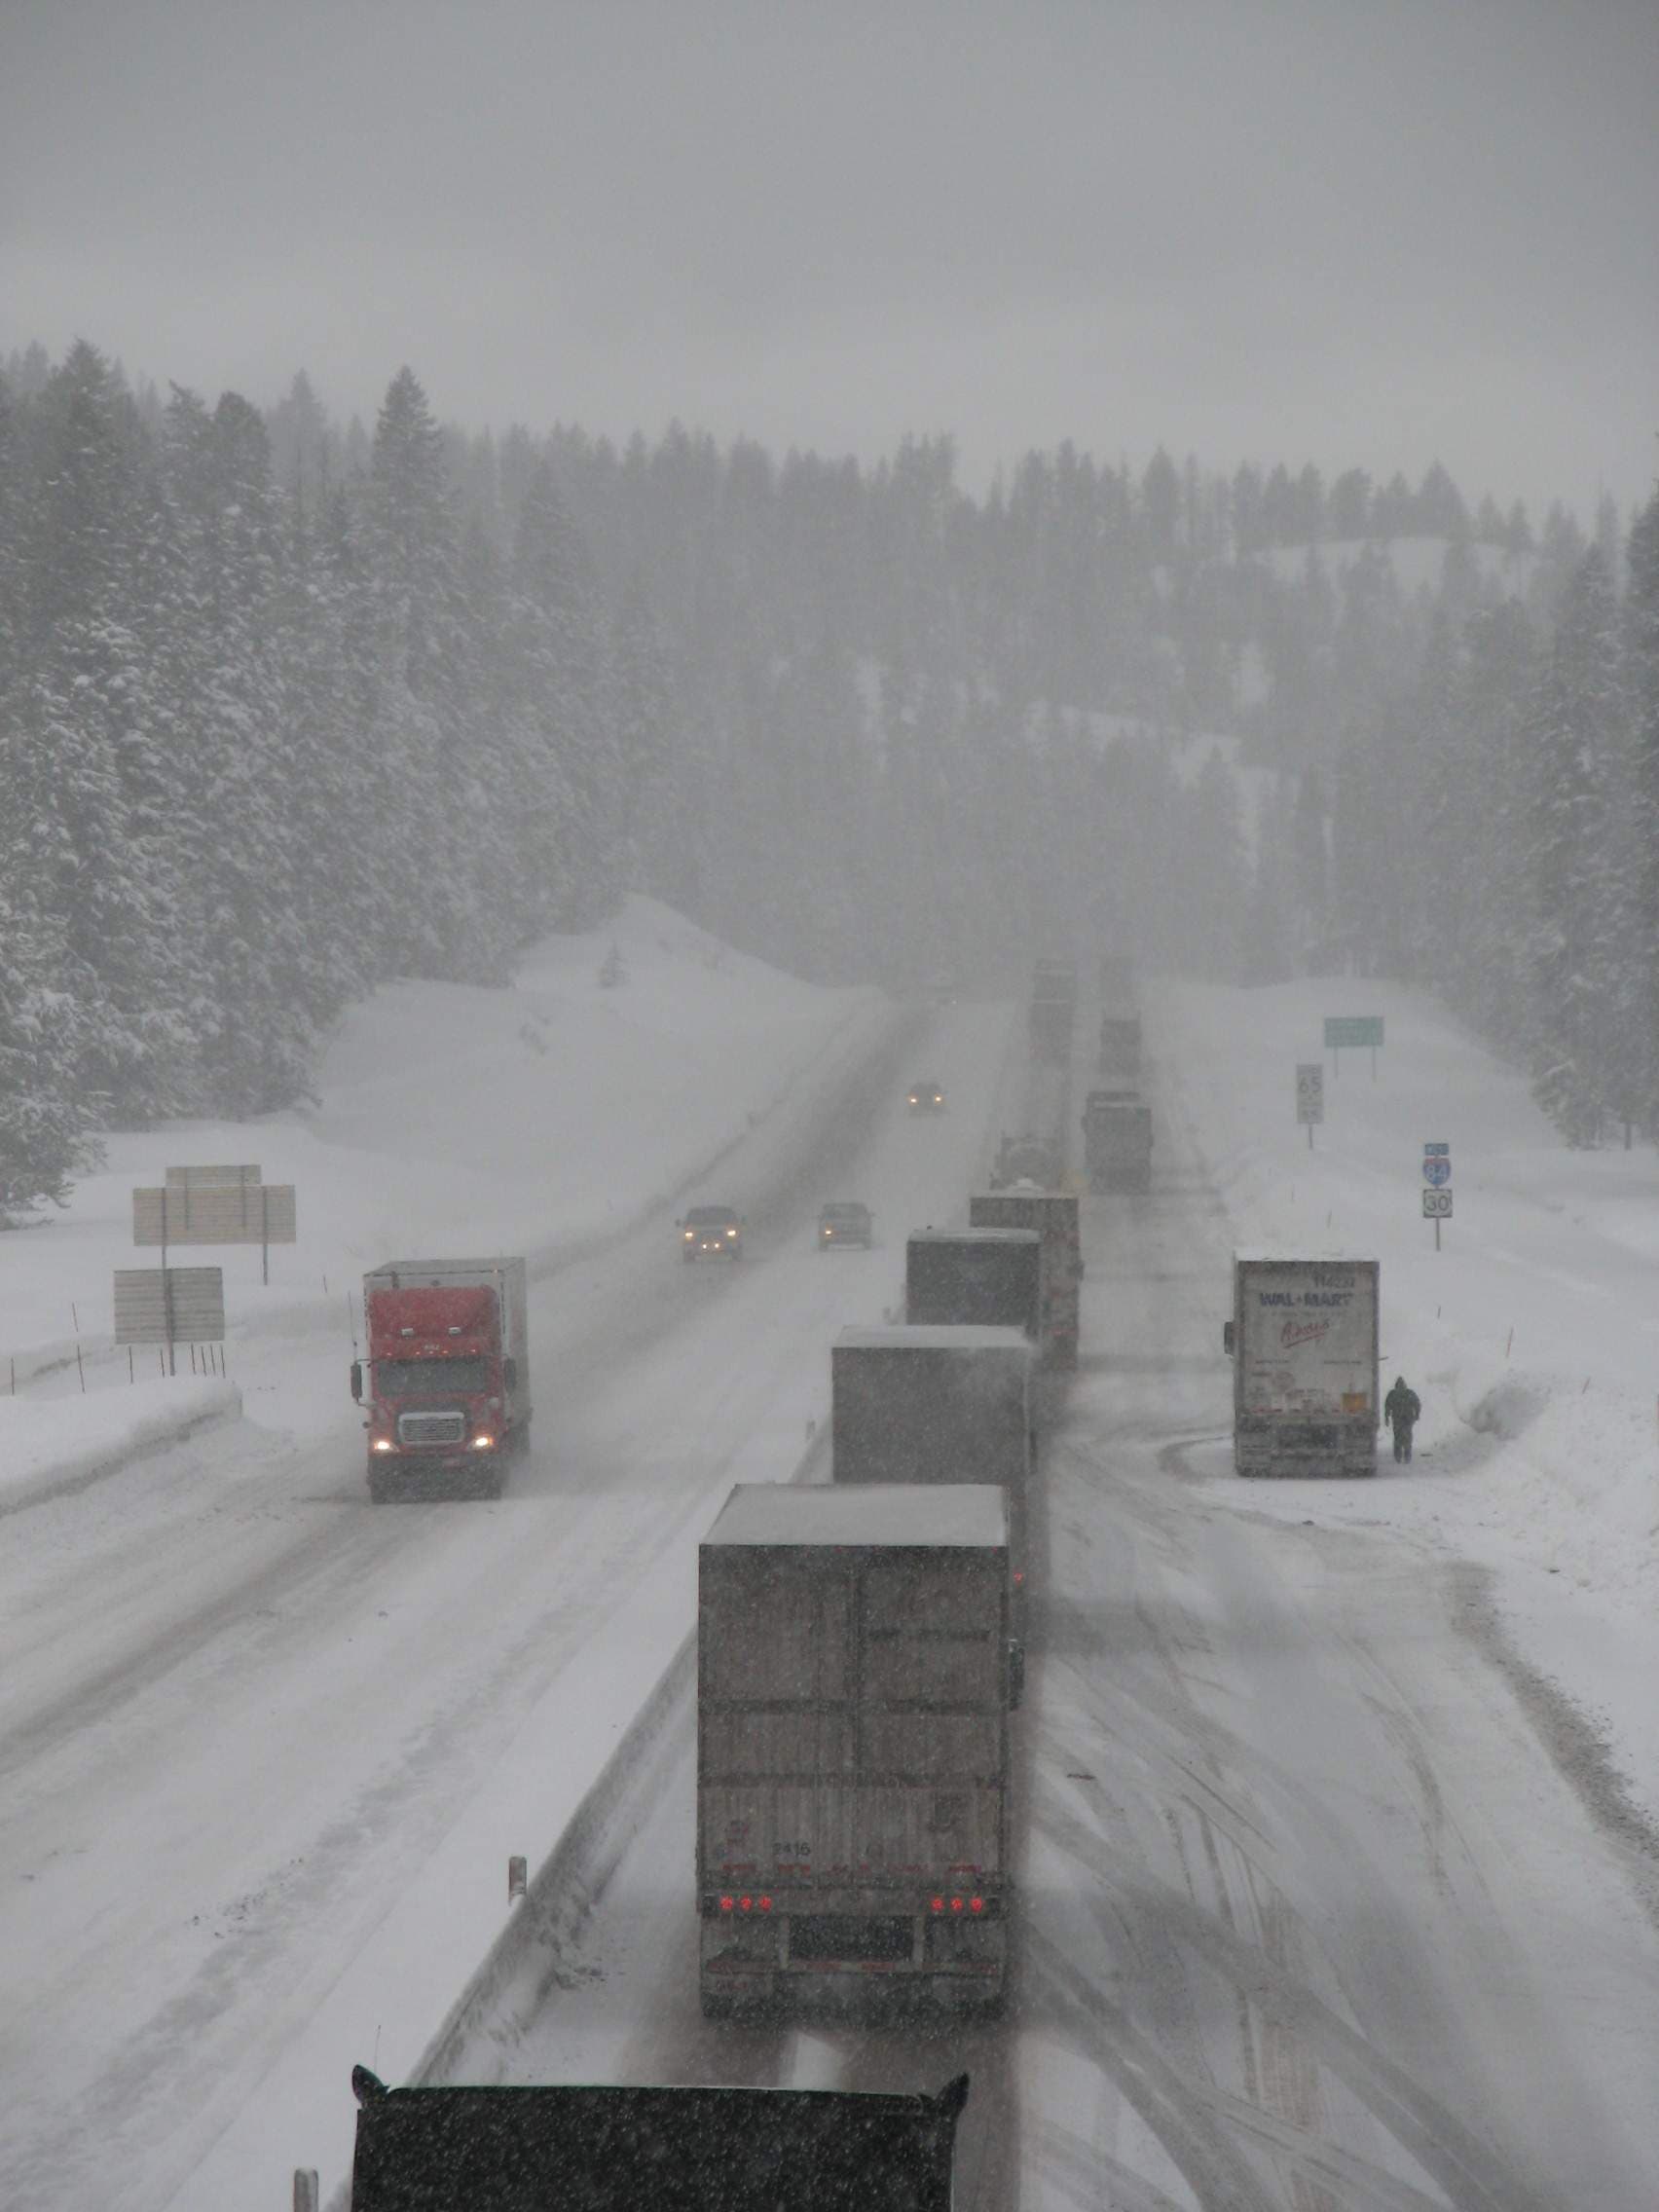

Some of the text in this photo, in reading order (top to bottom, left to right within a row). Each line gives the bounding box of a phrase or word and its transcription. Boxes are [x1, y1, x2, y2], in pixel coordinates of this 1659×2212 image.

[1299, 1076, 1322, 1094] 65
[1427, 1165, 1447, 1180] 84
[1426, 1196, 1449, 1212] 30
